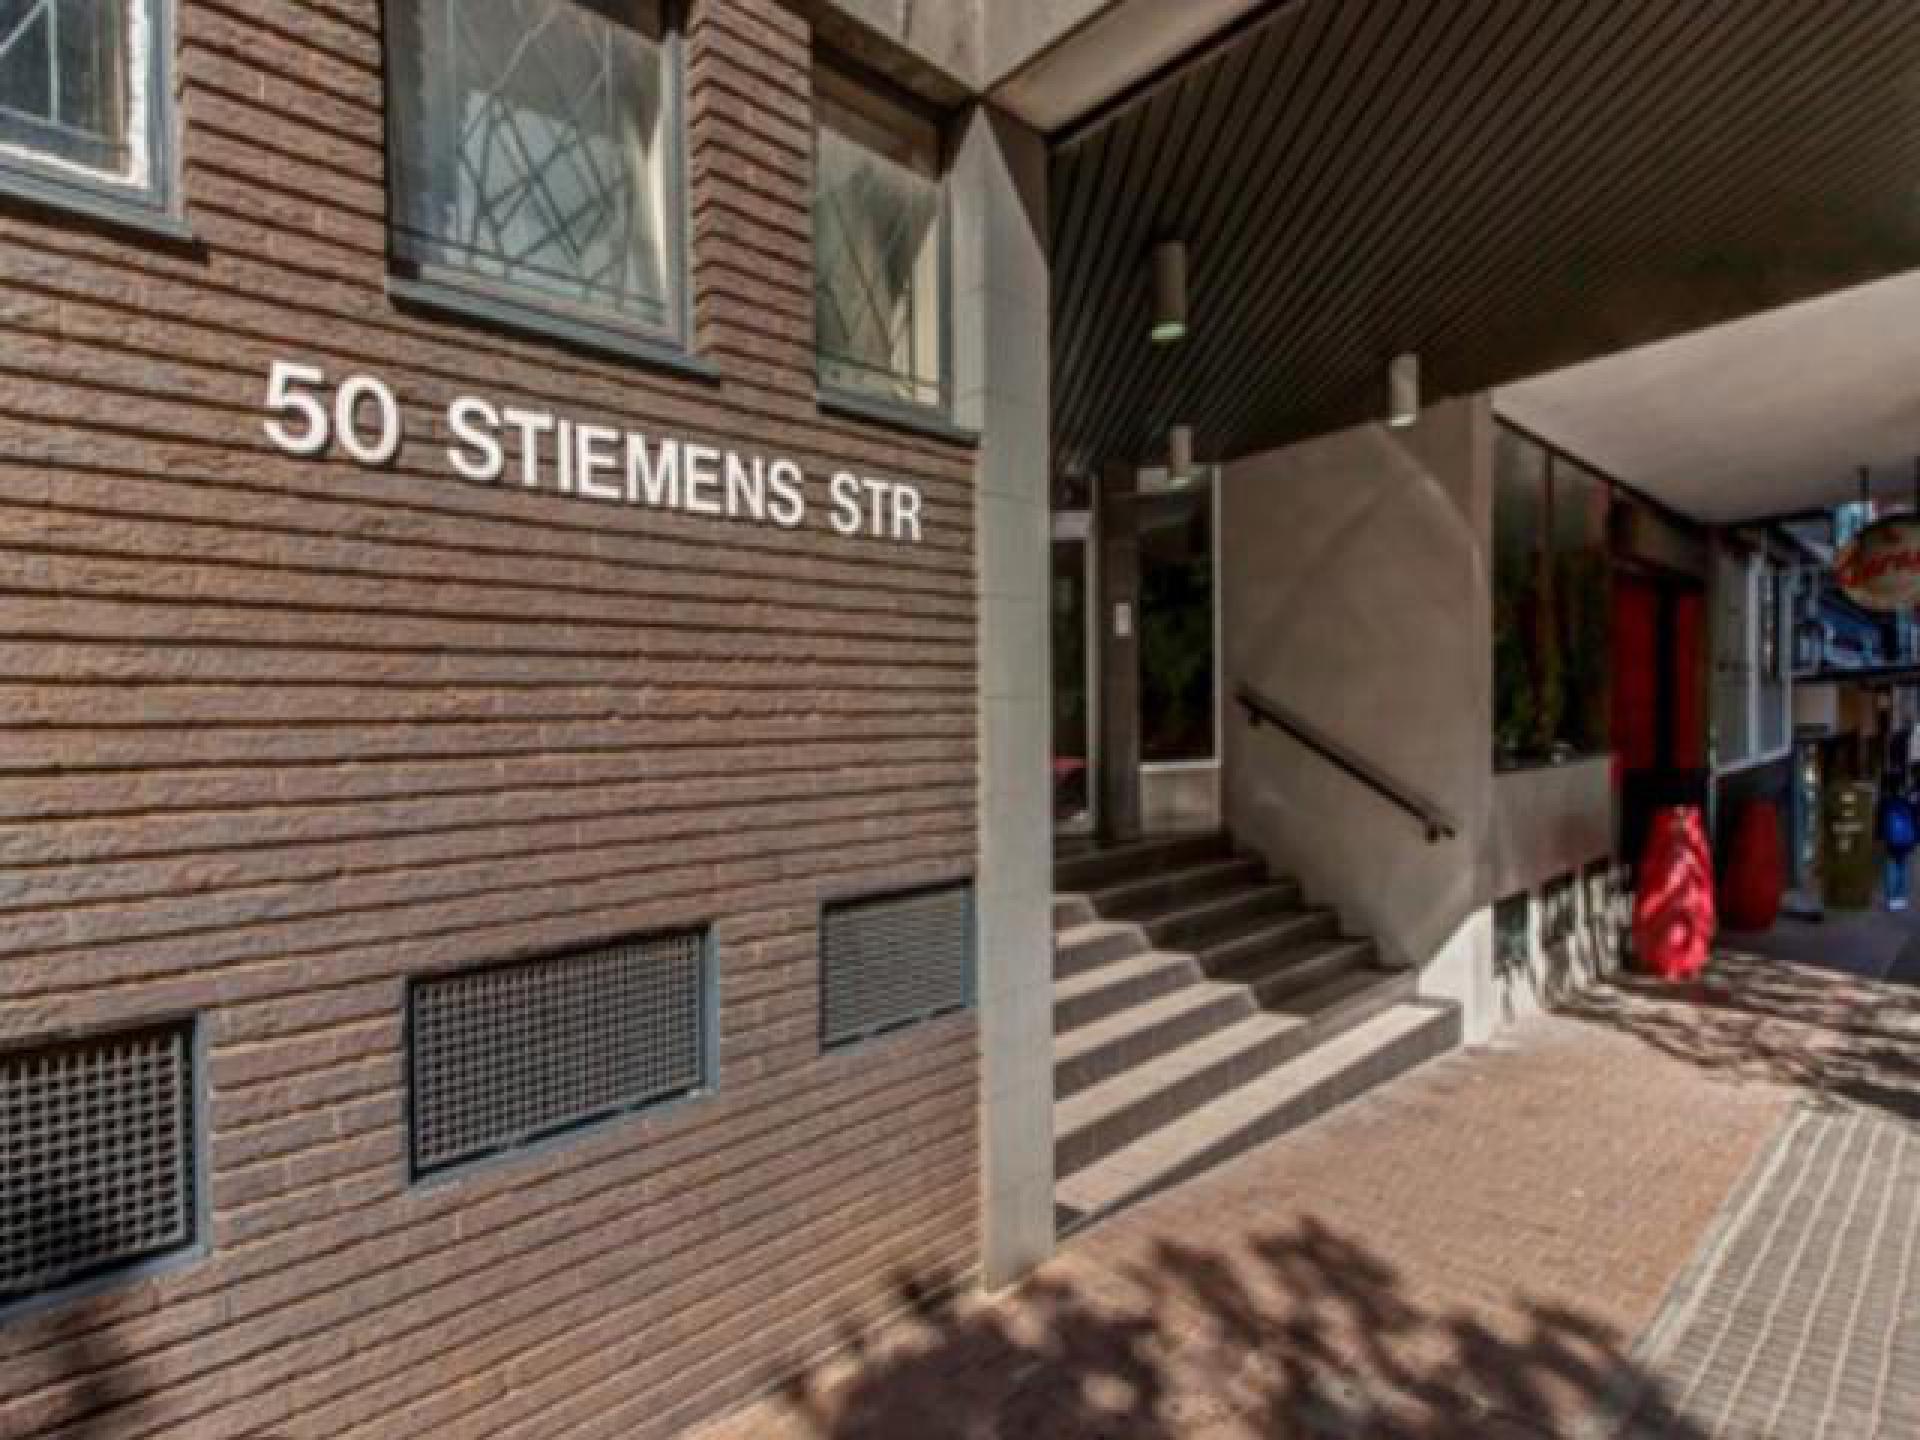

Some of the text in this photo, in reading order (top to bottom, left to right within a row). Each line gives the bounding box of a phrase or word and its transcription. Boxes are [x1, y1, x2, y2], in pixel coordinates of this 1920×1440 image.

[263, 360, 923, 542] 50 STIEMENS STR
